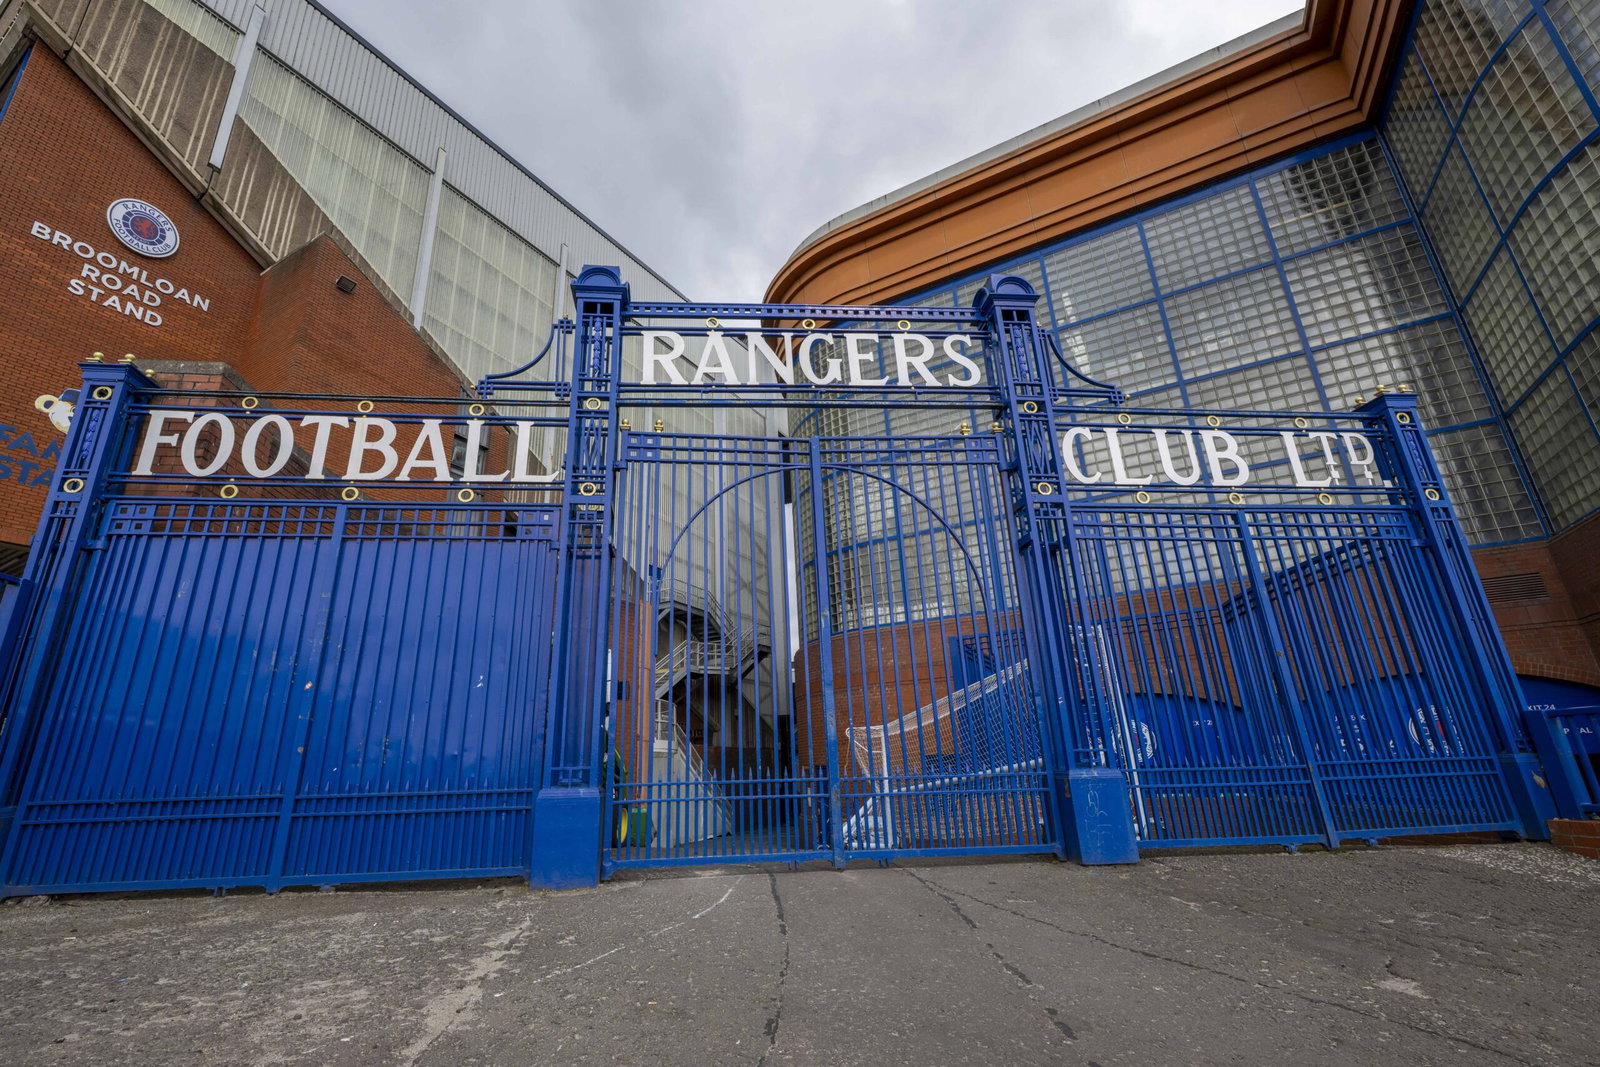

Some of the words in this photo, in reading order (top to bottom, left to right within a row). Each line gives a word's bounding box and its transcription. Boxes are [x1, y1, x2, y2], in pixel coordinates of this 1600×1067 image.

[114, 218, 152, 252] FOOTBALL
[152, 242, 171, 253] CLUB
[122, 203, 173, 232] RANGERS
[30, 221, 210, 312] BROOMLOAN
[81, 263, 162, 307] ROAD
[67, 279, 163, 327] STAND
[640, 330, 982, 387] RANGERS
[131, 410, 560, 482] FOOTBALL
[1062, 426, 1250, 487] CLUB
